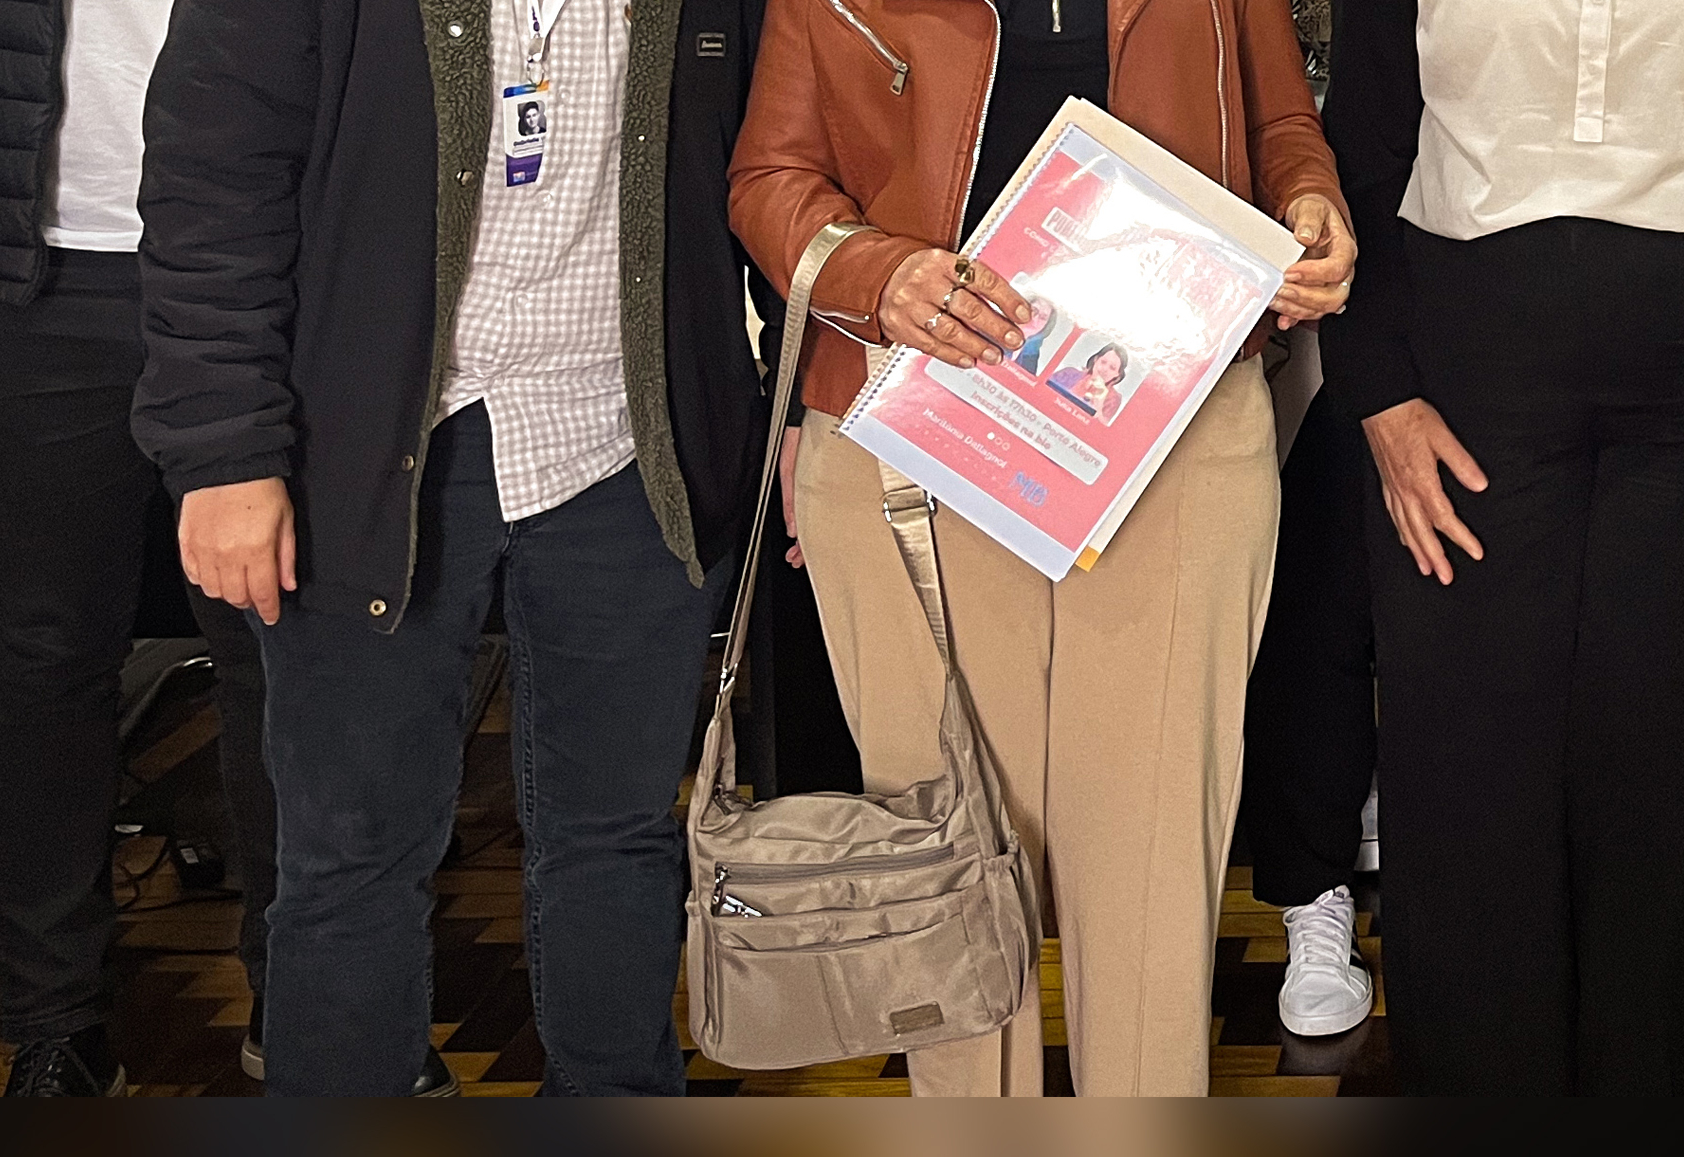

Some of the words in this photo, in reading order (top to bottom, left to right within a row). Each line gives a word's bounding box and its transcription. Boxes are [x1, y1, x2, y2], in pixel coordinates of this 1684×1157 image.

[970, 390, 1021, 429] Inscrições
[1043, 422, 1070, 446] Porto
[1069, 442, 1101, 468] Alegre
